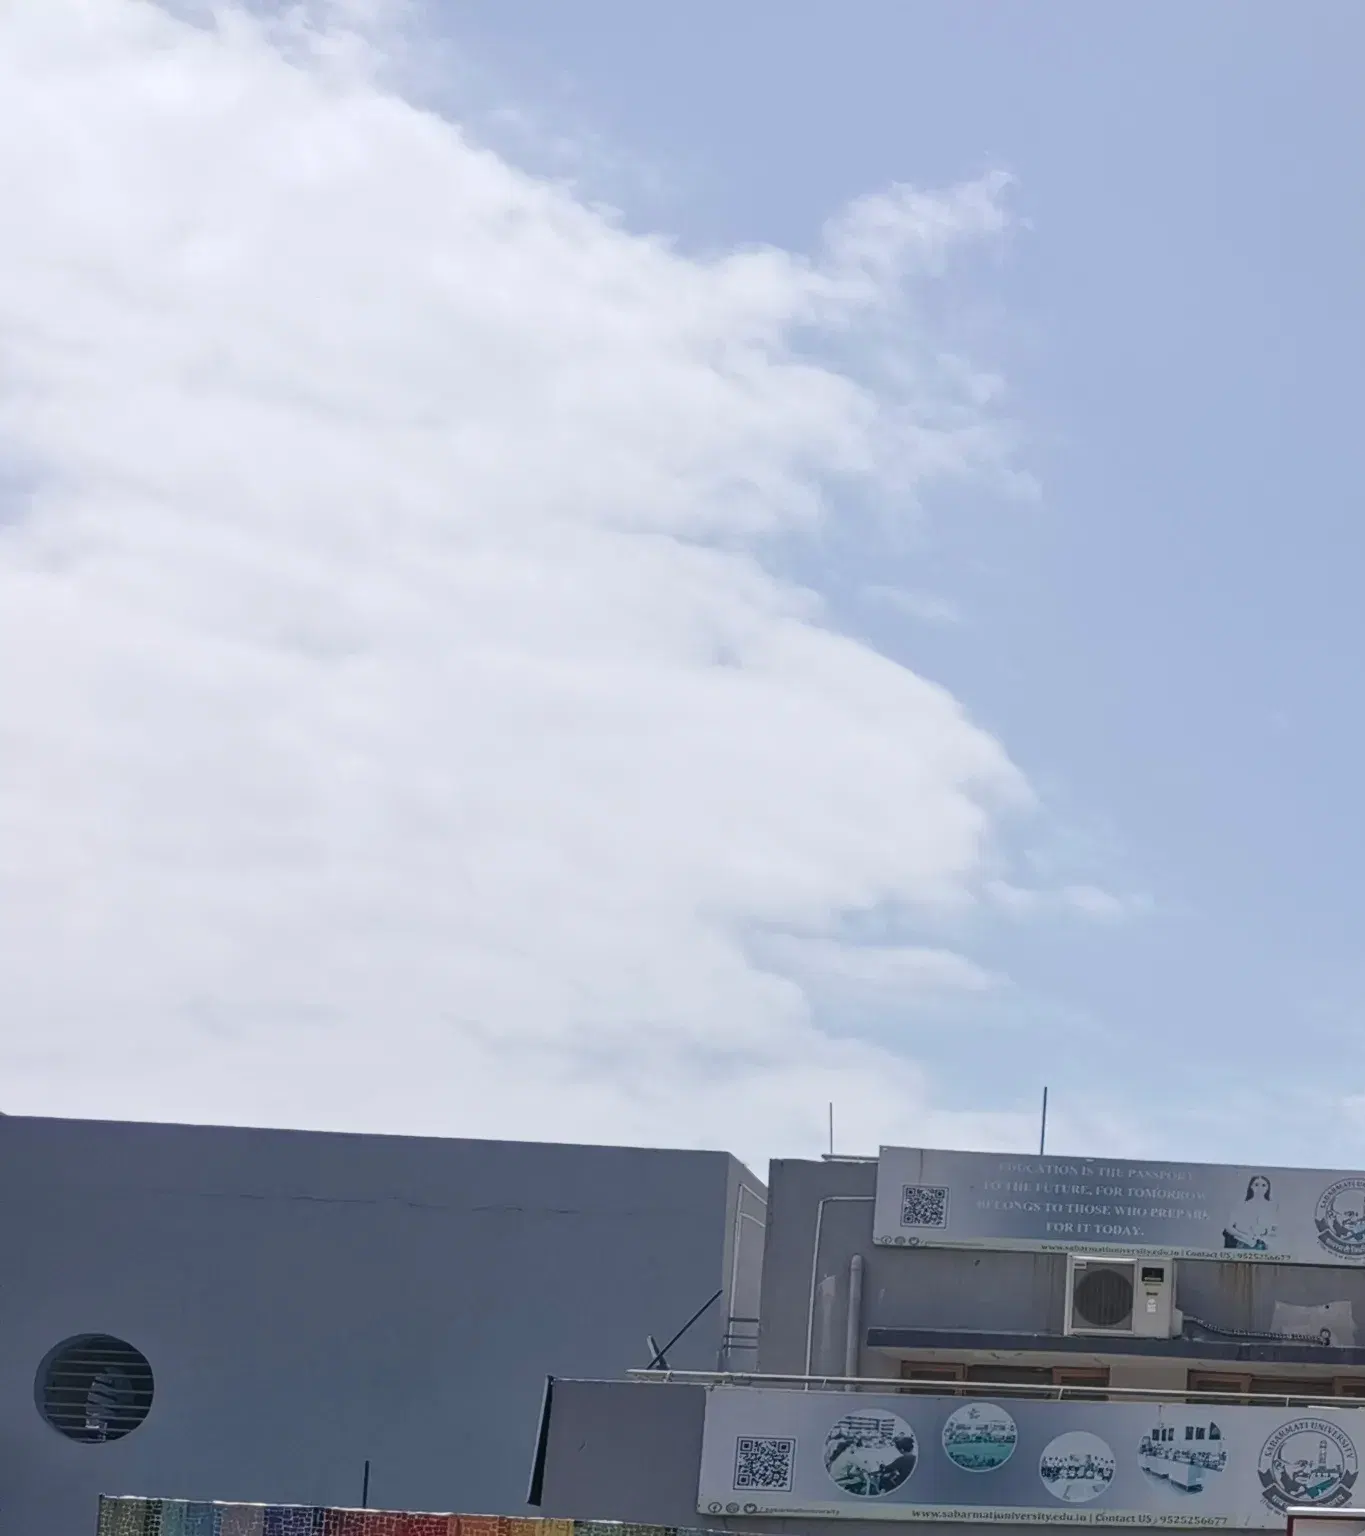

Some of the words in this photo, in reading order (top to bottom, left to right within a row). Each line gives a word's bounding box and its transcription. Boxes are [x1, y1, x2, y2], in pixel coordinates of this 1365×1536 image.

[1081, 1164, 1095, 1176] IS
[1098, 1165, 1124, 1178] THE
[1128, 1167, 1194, 1182] PASSPORT
[983, 1179, 1002, 1193] TO
[1005, 1180, 1032, 1193] THE
[1096, 1185, 1123, 1197] FOR
[1127, 1186, 1208, 1202] TOMORROW
[976, 1198, 1041, 1214] BELONGS
[1044, 1201, 1063, 1213] TO
[1065, 1202, 1111, 1216] THOSE
[1114, 1205, 1148, 1218] WHO
[1150, 1207, 1210, 1221] PREPARE
[1046, 1220, 1074, 1233] FOR
[1077, 1222, 1091, 1234] IT
[1093, 1224, 1145, 1237] TODAY.
[1264, 1421, 1309, 1458] SABARMATI
[1310, 1421, 1355, 1459] UNIVERSITY
[1095, 1512, 1137, 1524] Contact
